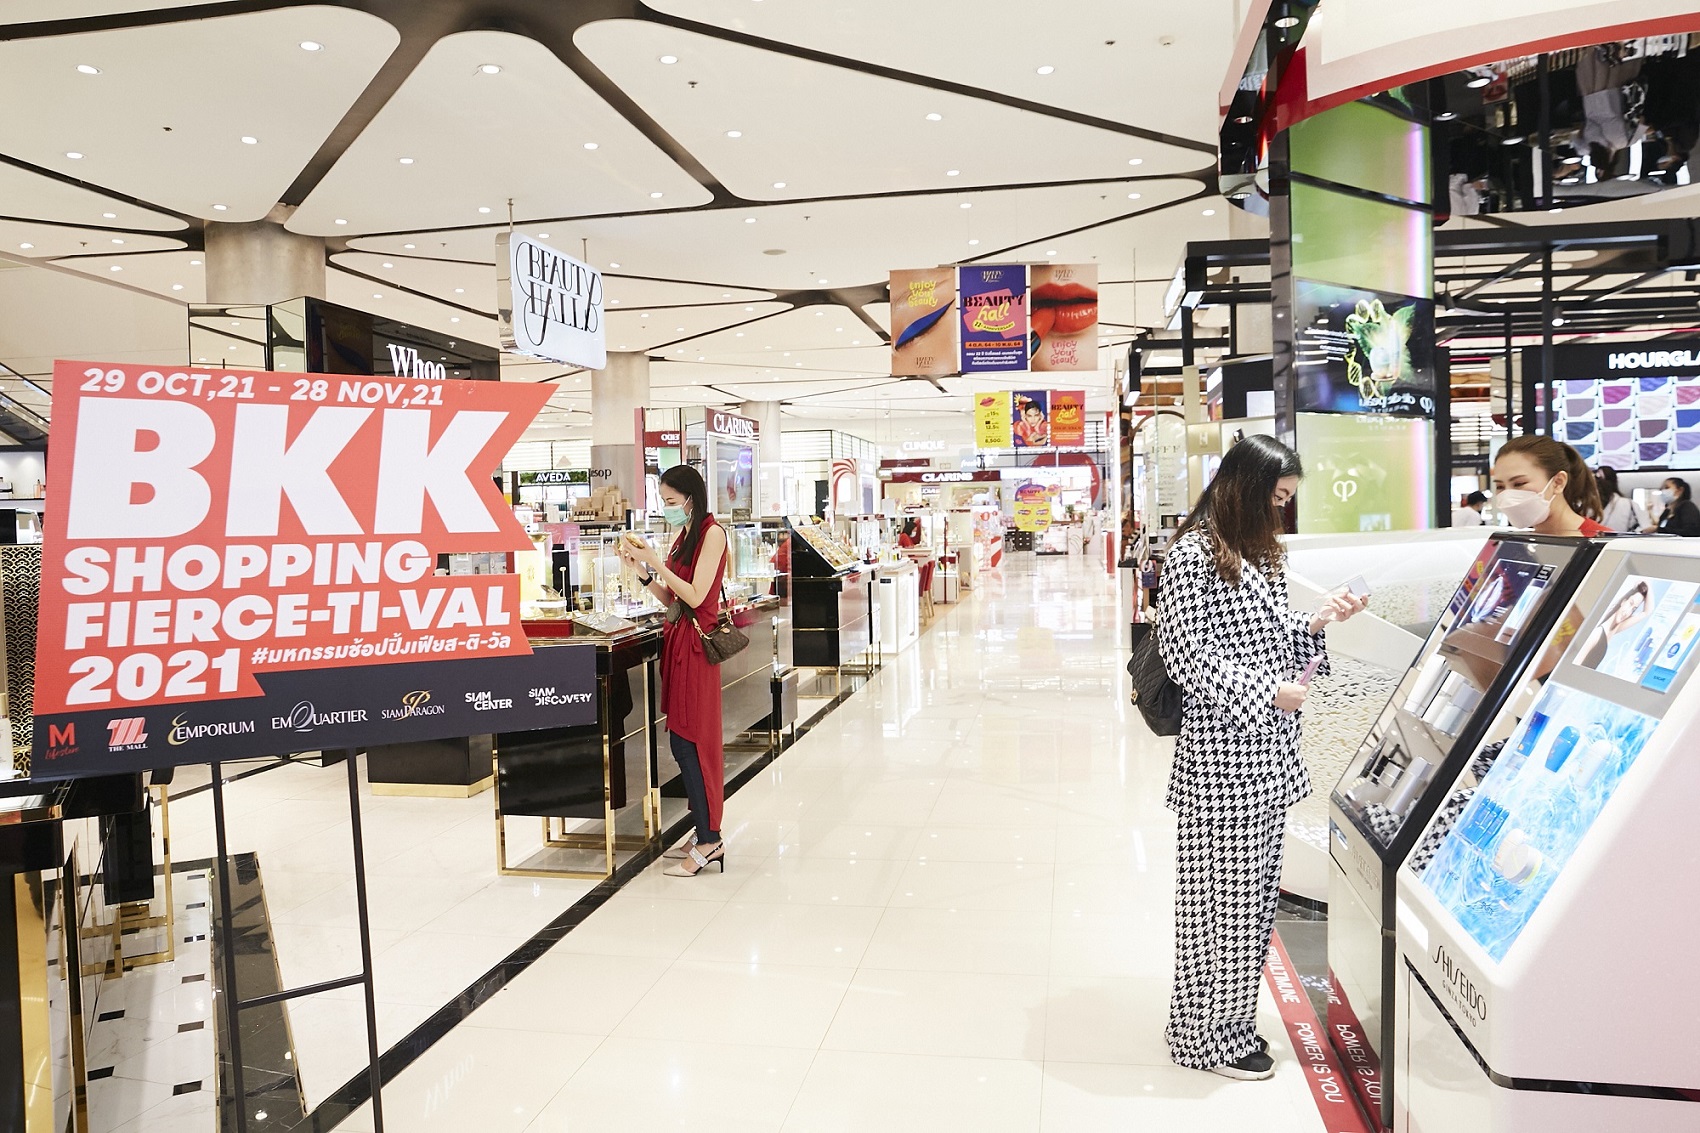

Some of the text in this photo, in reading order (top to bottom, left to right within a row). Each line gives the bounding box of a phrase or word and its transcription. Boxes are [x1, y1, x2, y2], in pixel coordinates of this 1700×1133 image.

[516, 242, 602, 305] BEAUTY
[963, 295, 1024, 307] BEAUTY
[977, 302, 1010, 321] hall
[387, 344, 446, 380] Whoo
[80, 368, 125, 393] 29
[136, 372, 256, 402] OCT,21
[290, 379, 328, 400] 28
[336, 381, 444, 409] NOV,21
[713, 413, 754, 438] CLARINS
[66, 396, 510, 540] BKK
[535, 472, 571, 482] AVEDA
[921, 472, 974, 482] CLARINS
[62, 540, 432, 596] SHOPPING
[64, 586, 511, 650] FIERCE-TI-VAL
[65, 648, 241, 706] 2021
[529, 687, 555, 698] SIAM
[465, 691, 491, 703] SIAM
[474, 699, 513, 711] CENTER
[169, 713, 255, 745] EMPORIUM
[1432, 945, 1487, 1021] SHISEIDO
[1294, 1022, 1345, 1103] POWER IS YOU
